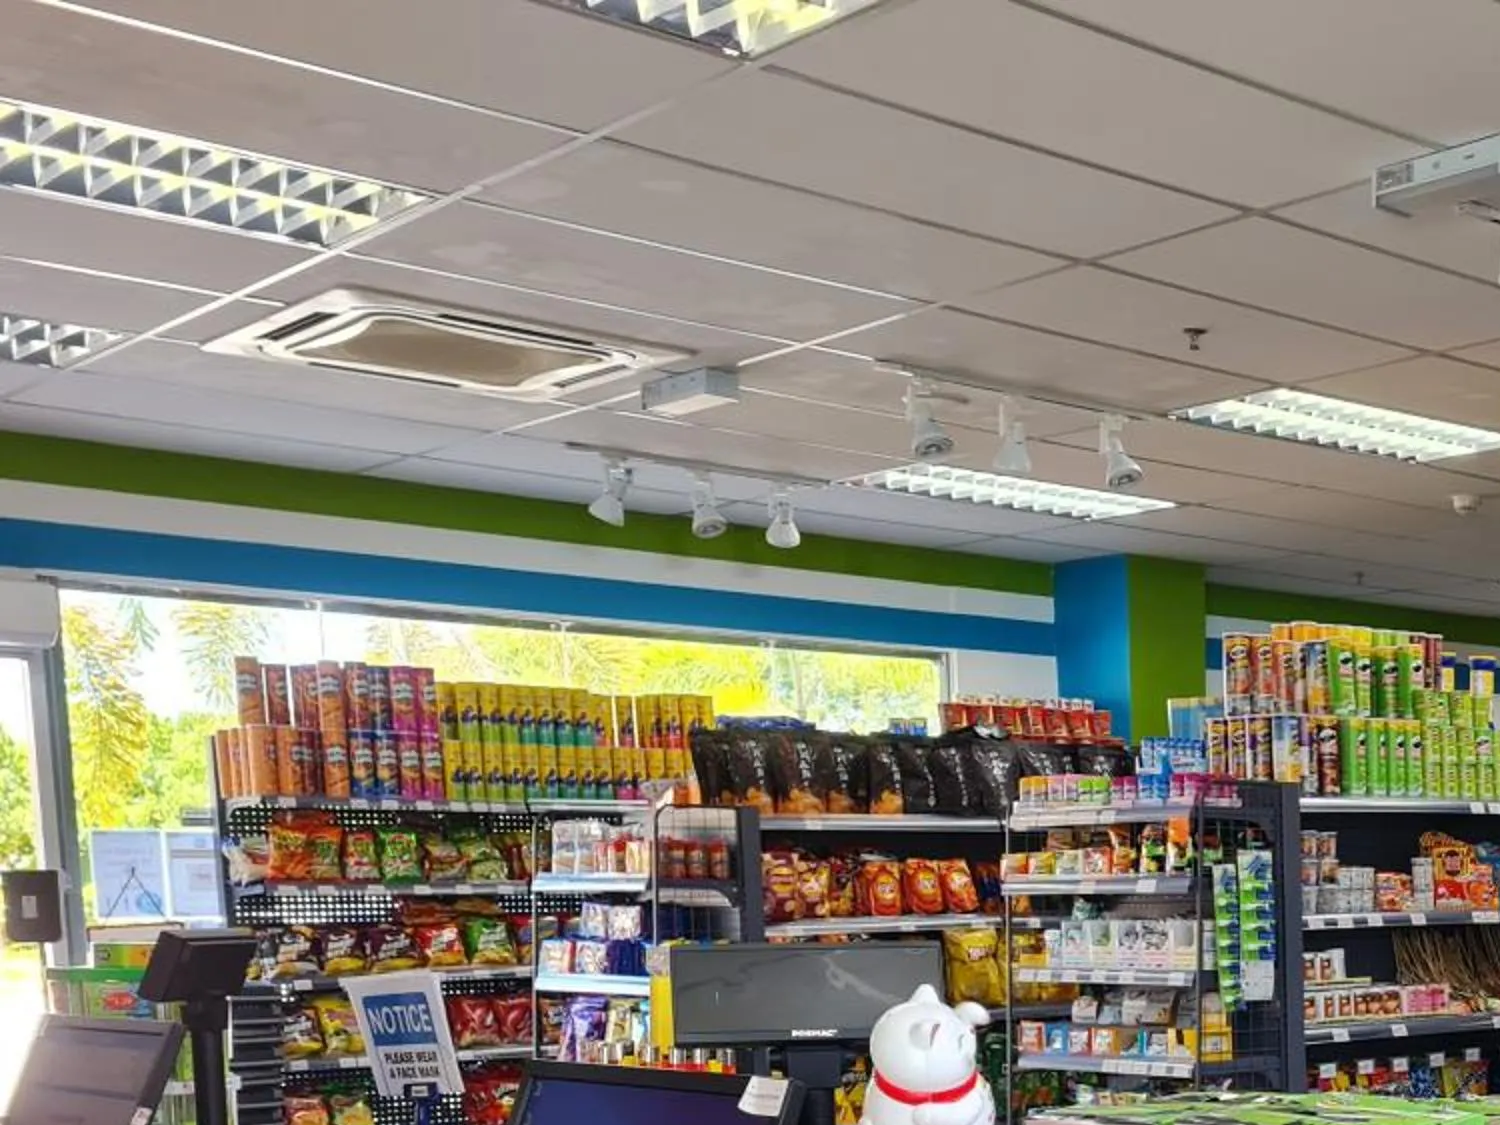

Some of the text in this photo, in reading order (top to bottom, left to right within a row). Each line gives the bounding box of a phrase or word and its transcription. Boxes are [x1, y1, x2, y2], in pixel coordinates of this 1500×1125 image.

[368, 1004, 432, 1035] NOTICE
[384, 1051, 438, 1065] PLEASE WEAR
[397, 1067, 418, 1079] FACE
[418, 1066, 440, 1078] MASK
